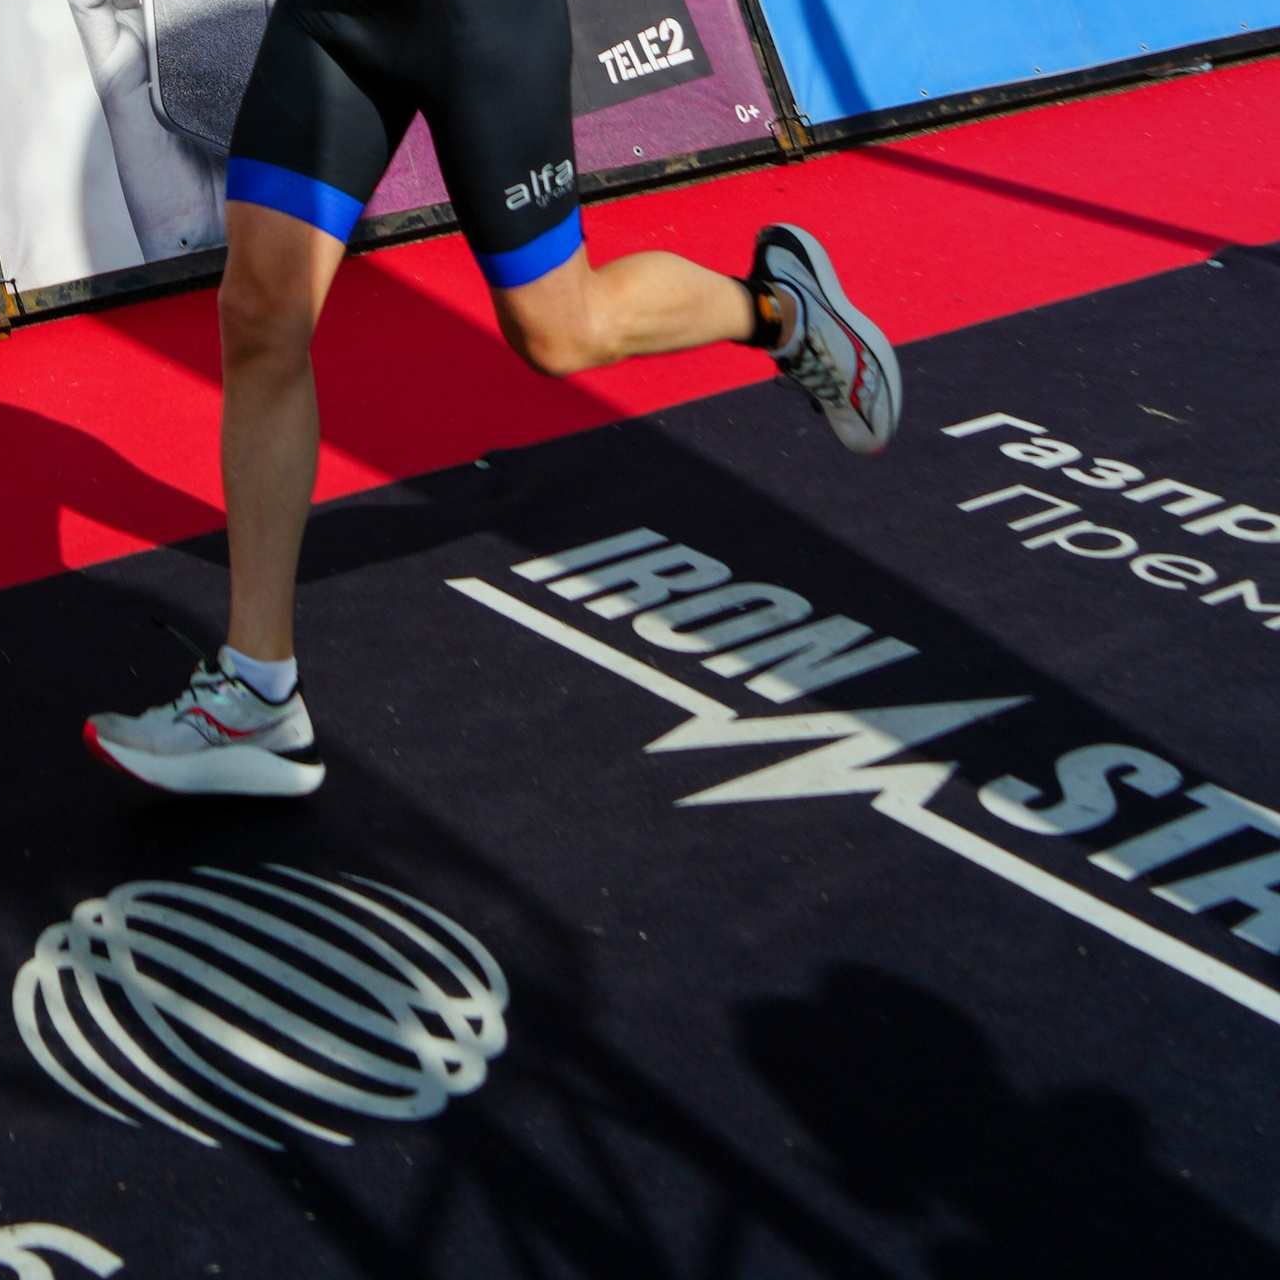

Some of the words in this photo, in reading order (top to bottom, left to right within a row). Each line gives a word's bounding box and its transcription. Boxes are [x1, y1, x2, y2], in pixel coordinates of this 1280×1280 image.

[598, 17, 694, 85] TELE2
[735, 104, 761, 124] 0+
[504, 159, 574, 210] alfa
[940, 412, 1280, 542] Газпр
[510, 527, 921, 703] IRON
